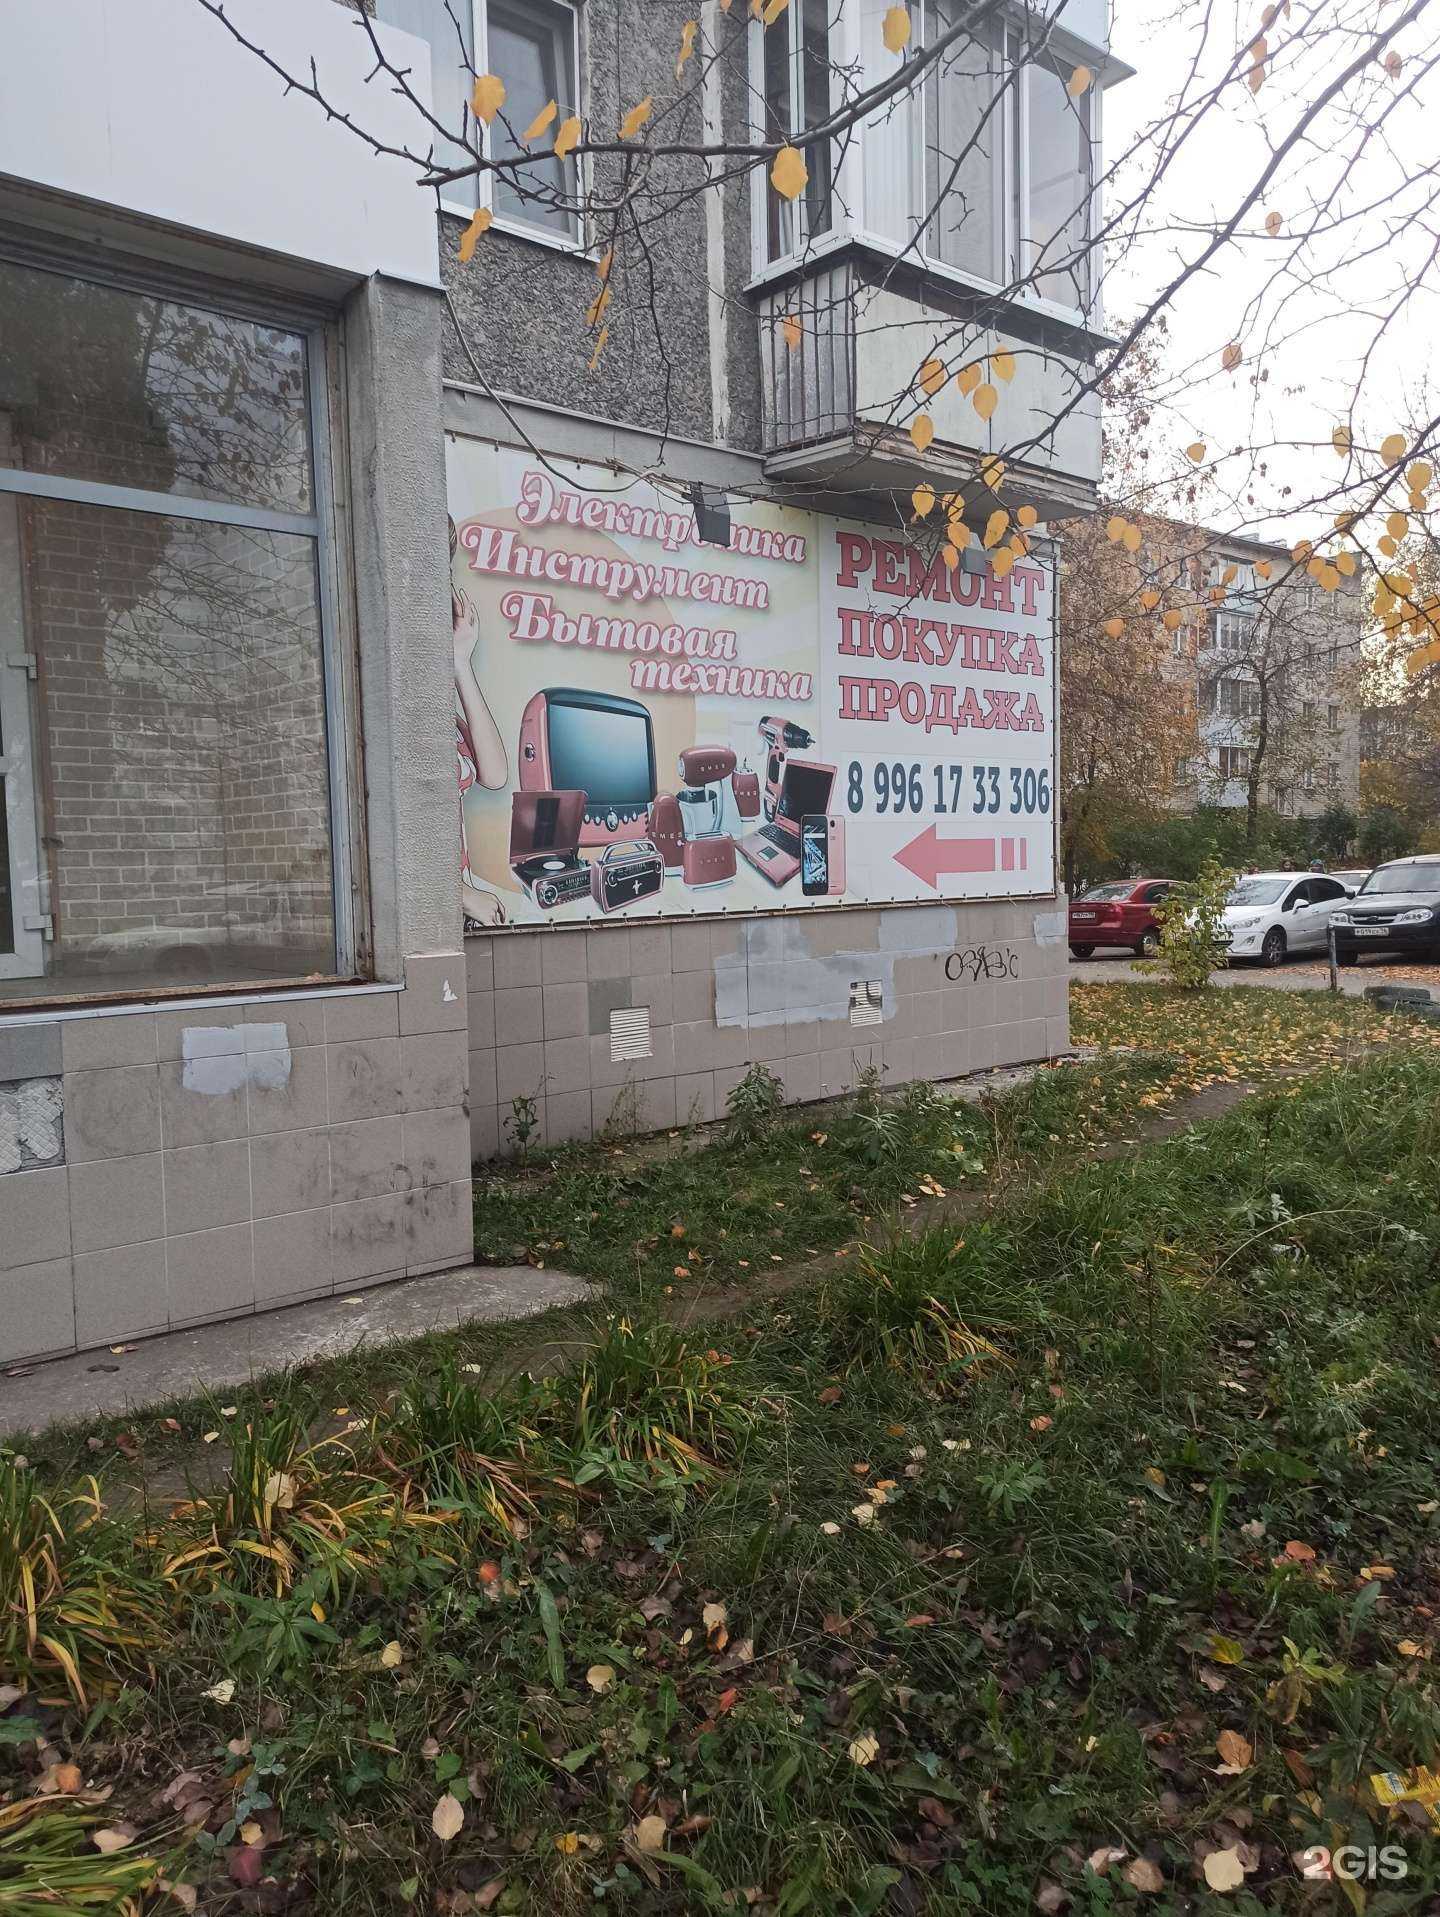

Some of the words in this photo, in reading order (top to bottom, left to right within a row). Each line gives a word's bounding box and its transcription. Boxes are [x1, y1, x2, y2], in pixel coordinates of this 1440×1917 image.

[460, 521, 770, 610] Инструмент
[836, 531, 1045, 616] РЕМОНТ
[500, 591, 737, 661] Бытовая
[838, 607, 1045, 677] ПОКУПКА
[630, 657, 814, 701] техника
[839, 676, 1045, 735] ПРОДАЖА
[847, 760, 864, 814] 8
[873, 762, 924, 814] 996
[933, 764, 963, 814] 17
[972, 766, 1001, 814] 33
[1009, 767, 1050, 815] 306
